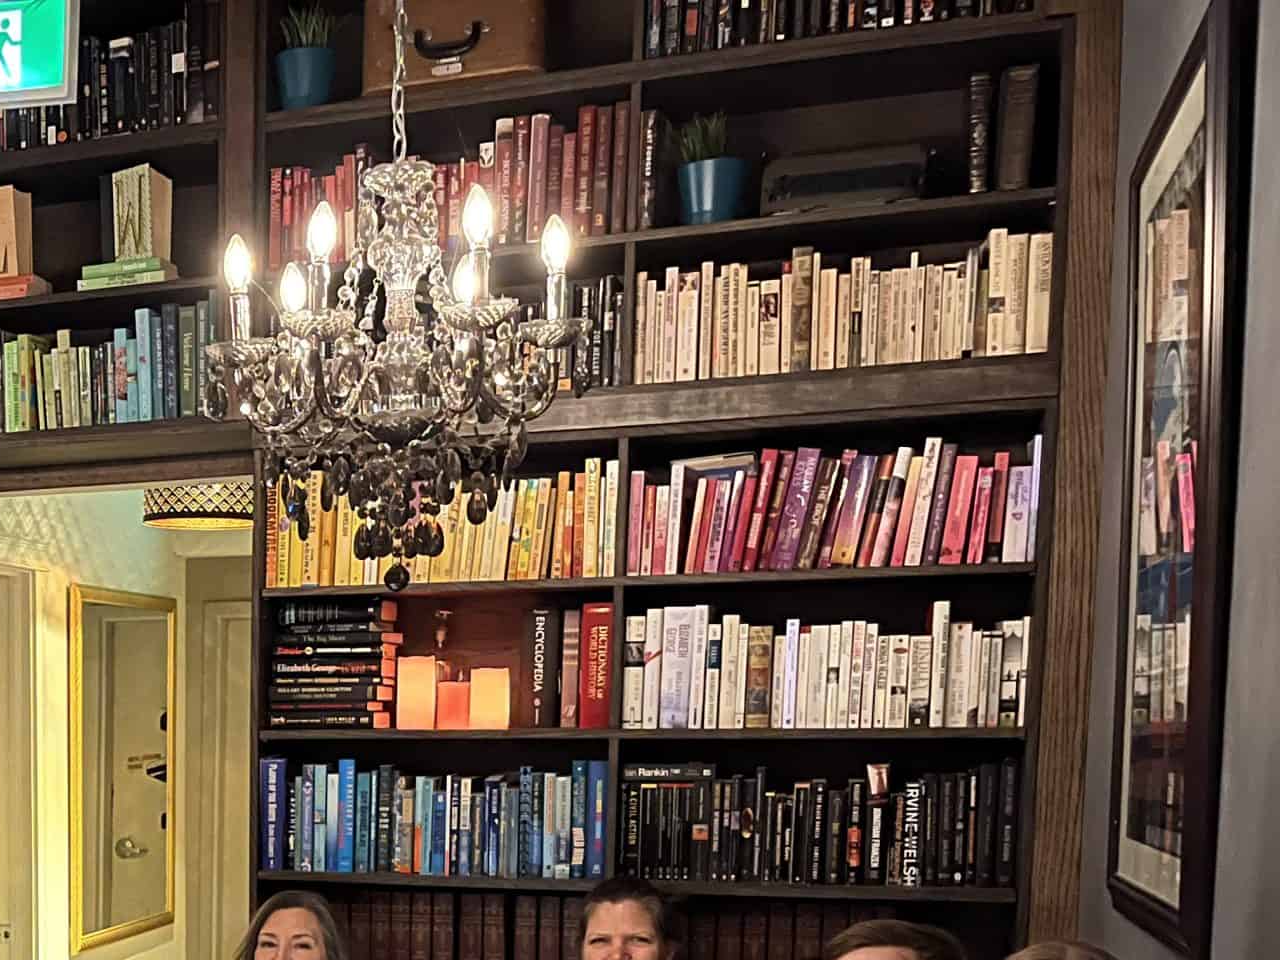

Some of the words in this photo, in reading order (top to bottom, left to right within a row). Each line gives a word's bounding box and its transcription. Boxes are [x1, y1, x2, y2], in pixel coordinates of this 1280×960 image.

[815, 485, 829, 502] THE
[534, 616, 546, 692] ENCYCLOPEDIA
[589, 626, 598, 660] WORLD
[597, 625, 609, 687] DICTIONARY
[678, 624, 691, 658] ELIZABETH
[587, 660, 597, 700] HISTORY
[638, 767, 669, 777] Rankin
[629, 798, 637, 817] CIVIL
[871, 808, 882, 839] JONATHAN
[904, 783, 920, 834] IRVINE
[628, 819, 637, 846] ACTION
[870, 839, 881, 869] FRANZEN
[903, 836, 919, 887] WELSH
